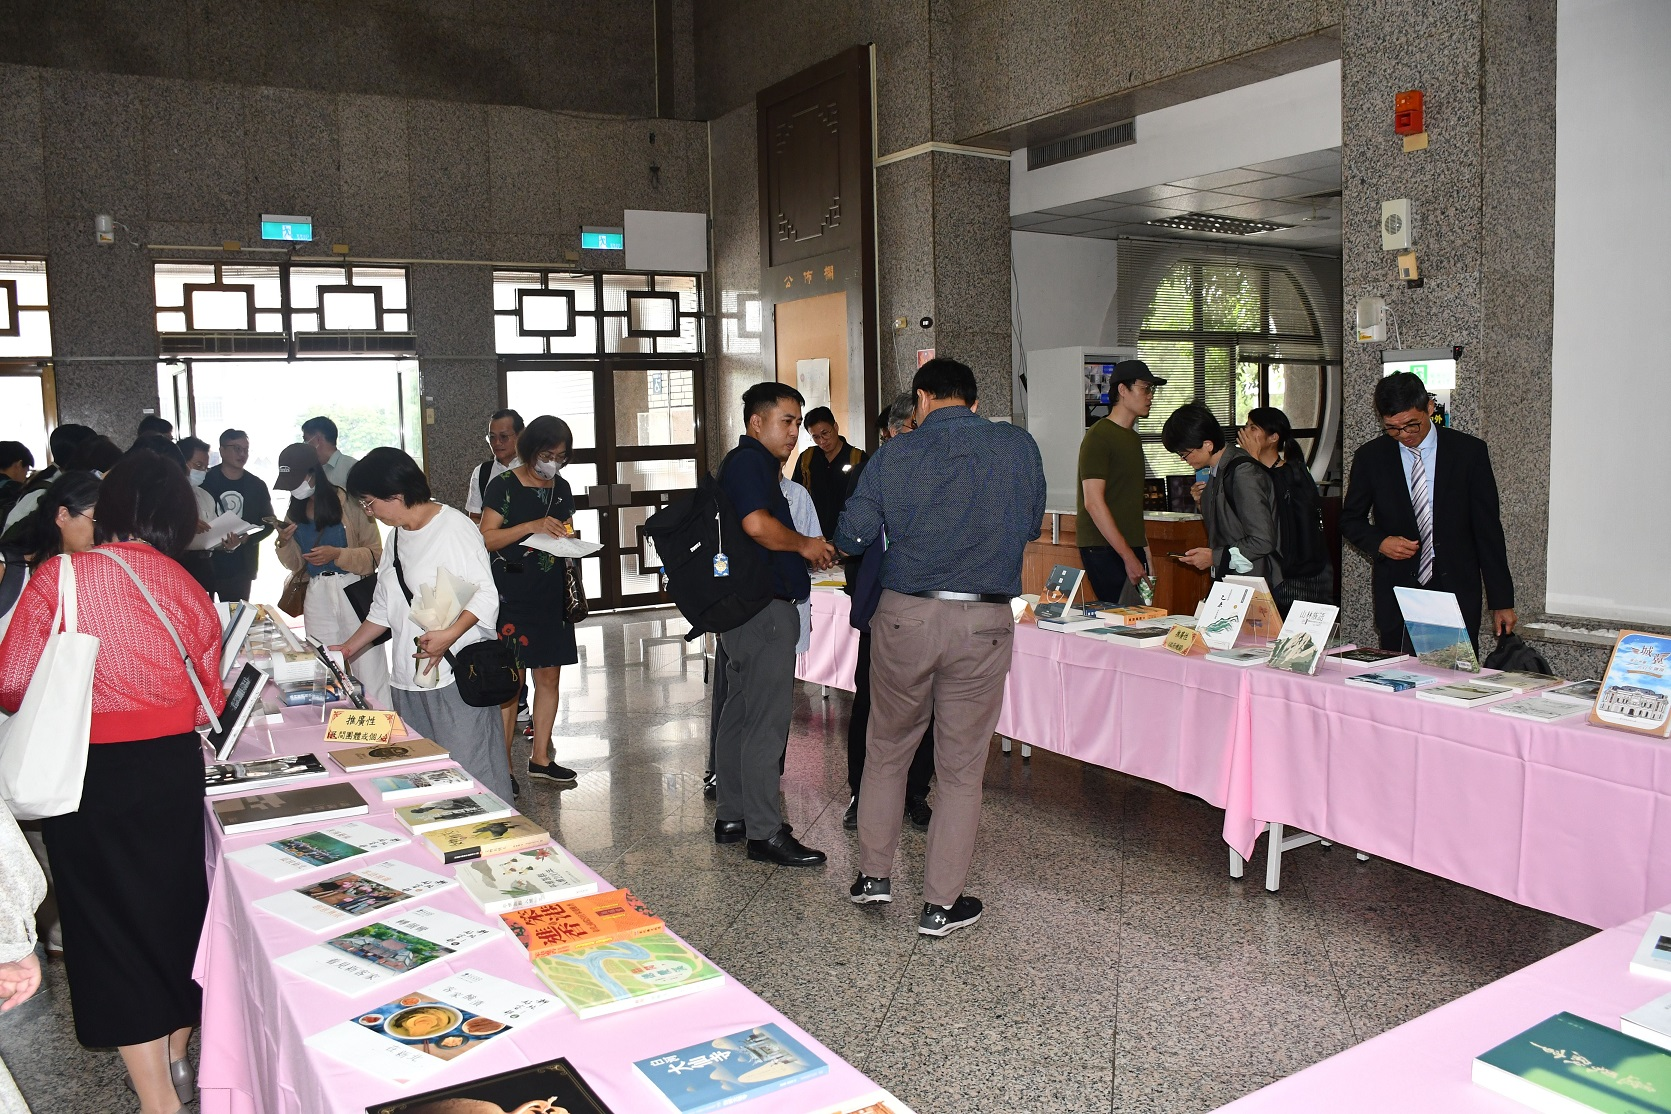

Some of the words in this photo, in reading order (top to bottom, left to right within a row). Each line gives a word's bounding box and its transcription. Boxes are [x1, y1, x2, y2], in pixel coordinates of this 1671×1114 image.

[345, 714, 376, 727] 推廣性
[650, 1054, 679, 1067] 白河
[667, 1049, 732, 1076] 大仙寺
